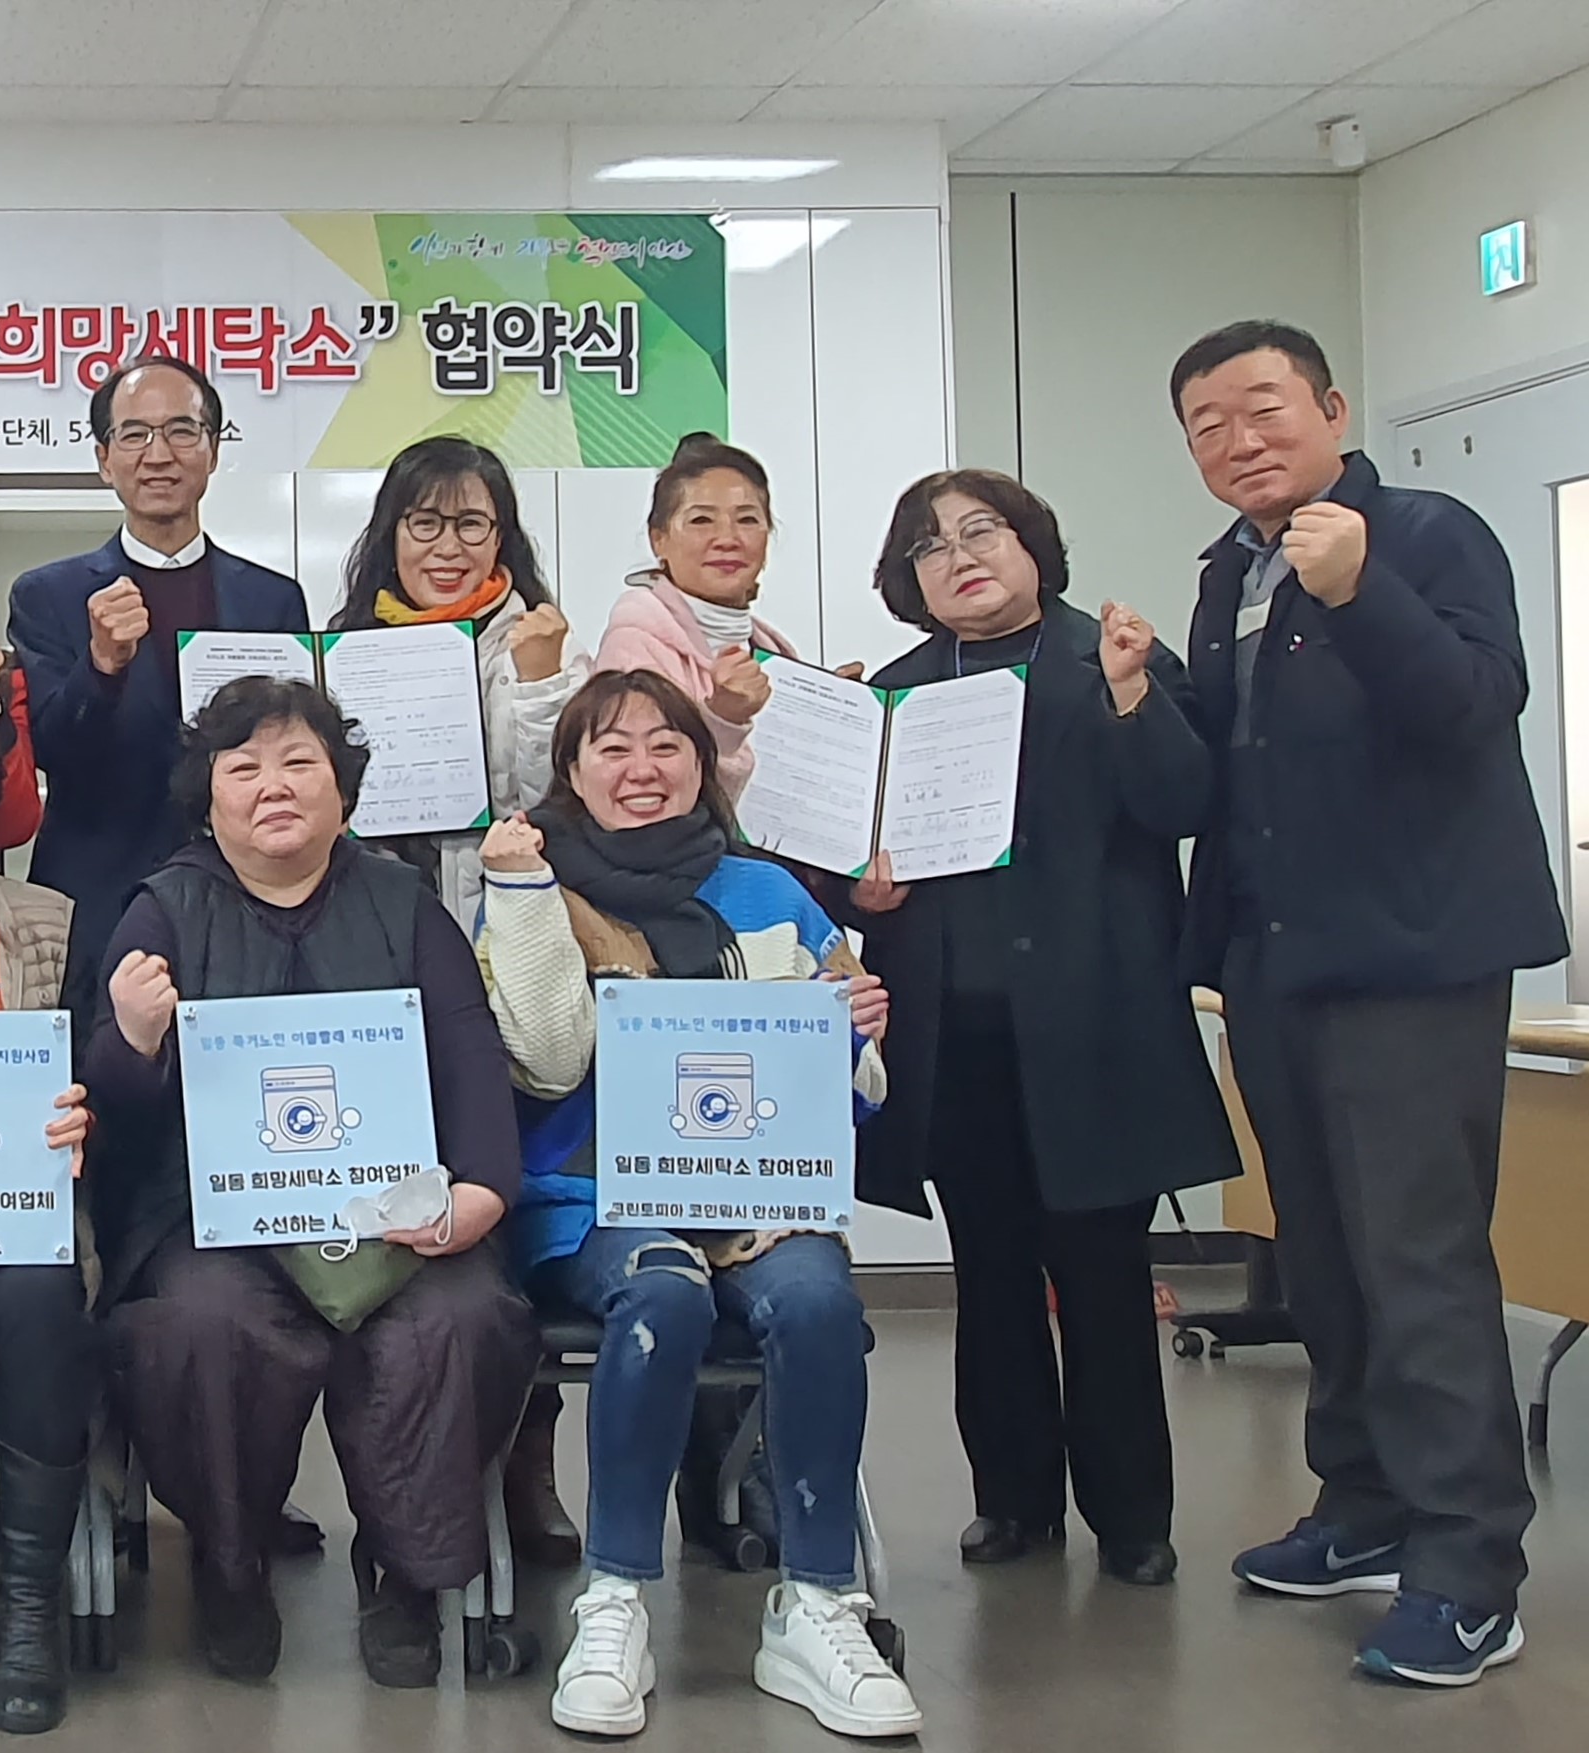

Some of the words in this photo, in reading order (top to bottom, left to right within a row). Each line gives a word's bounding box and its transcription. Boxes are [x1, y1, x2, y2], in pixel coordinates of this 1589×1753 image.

[423, 302, 637, 391] 협약식
[351, 1026, 404, 1043] 지원사업
[774, 1018, 830, 1034] 지원사업
[615, 1155, 651, 1174] 일동
[658, 1156, 752, 1176] 희망세탁소
[757, 1158, 833, 1178] 참여업체
[209, 1173, 245, 1193] 일동
[251, 1168, 343, 1189] 희망세탁소
[253, 1214, 326, 1235] 수선하는
